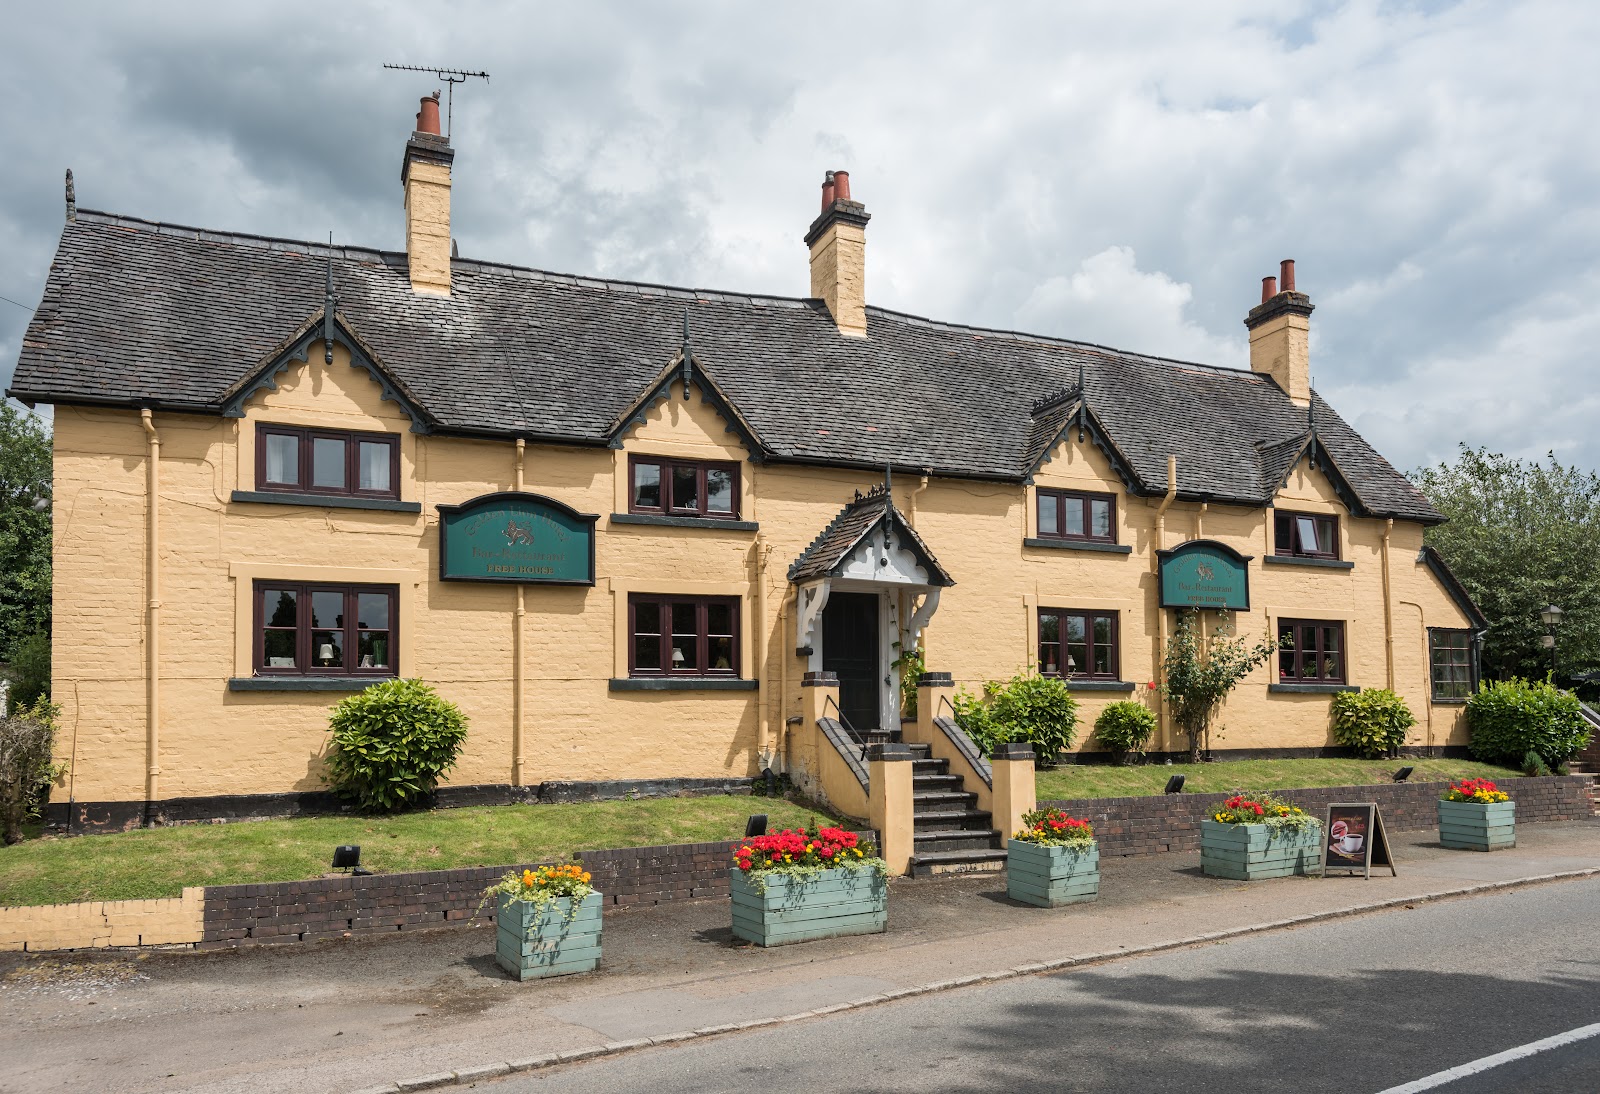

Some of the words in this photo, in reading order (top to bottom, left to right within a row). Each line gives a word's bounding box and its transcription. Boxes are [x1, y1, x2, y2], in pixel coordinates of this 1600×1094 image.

[464, 509, 505, 536] Golden
[509, 505, 537, 519] Lion
[541, 511, 571, 542] Hotel
[487, 564, 516, 573] FREE
[518, 565, 554, 575] HOUSE
